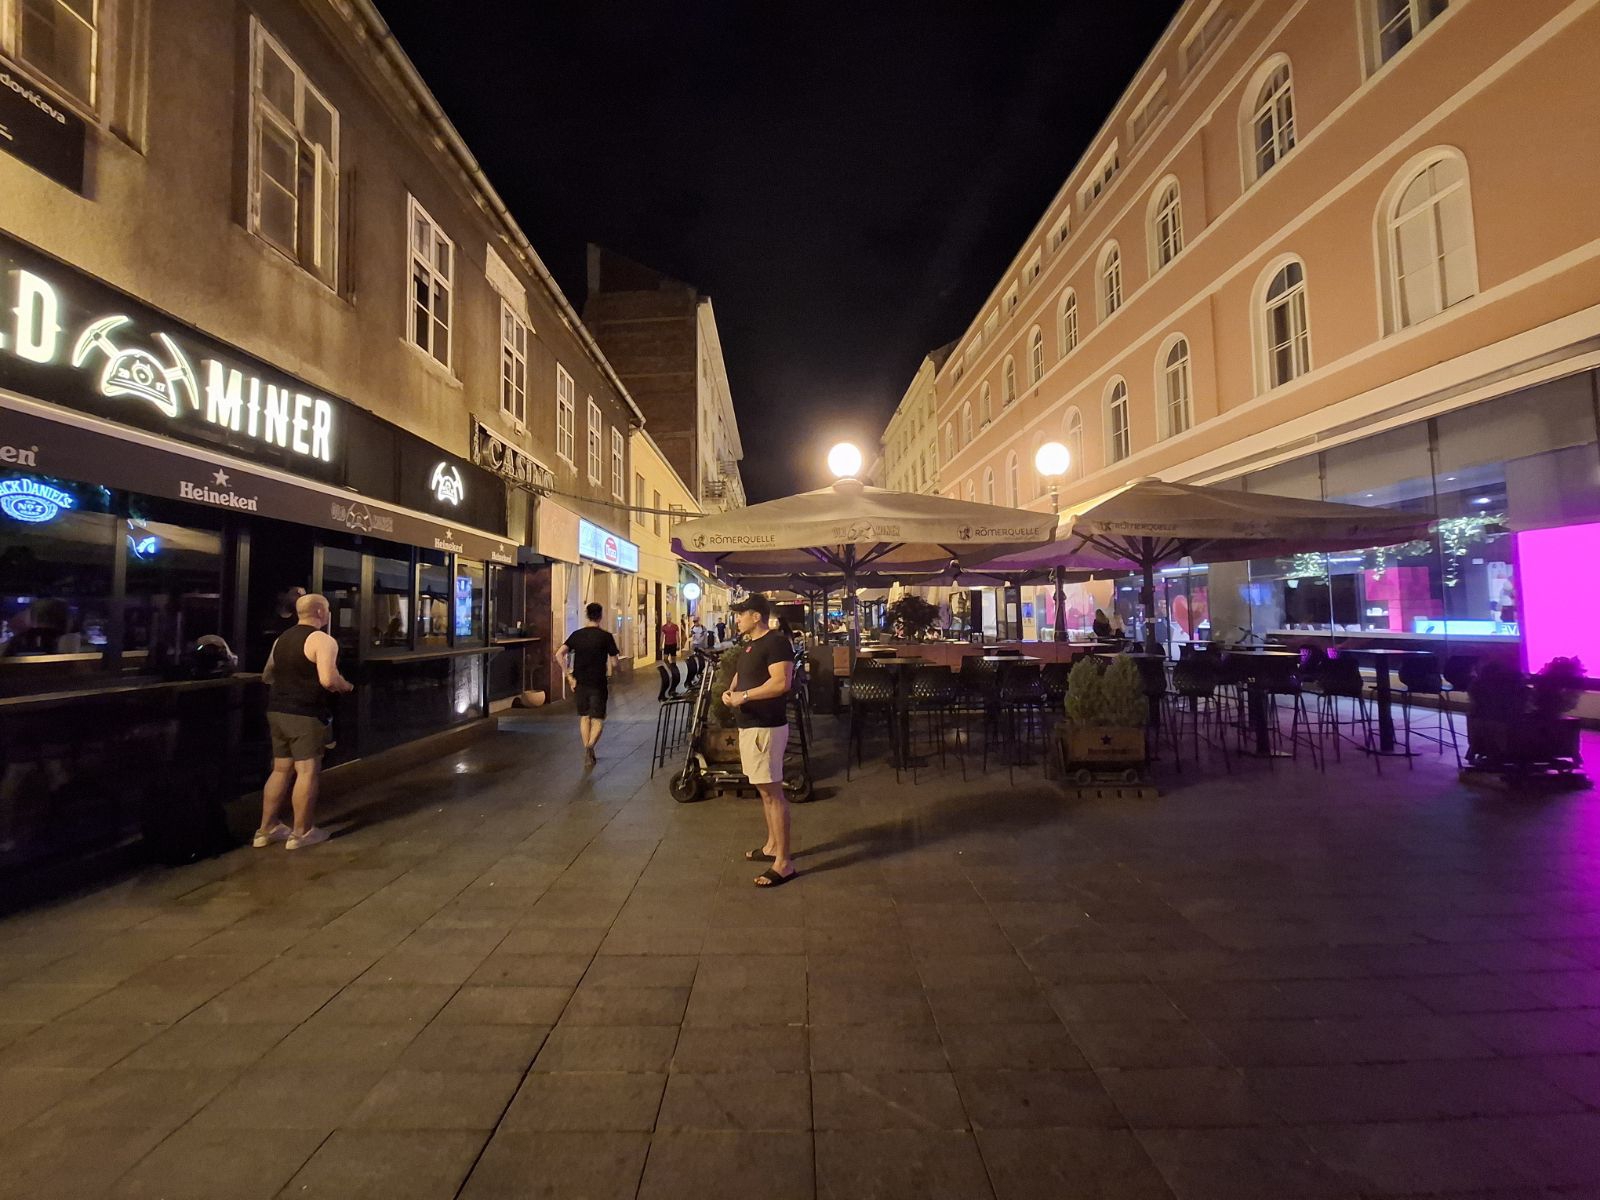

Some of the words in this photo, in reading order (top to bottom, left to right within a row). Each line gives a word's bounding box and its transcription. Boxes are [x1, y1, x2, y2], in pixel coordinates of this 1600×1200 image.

[205, 359, 331, 462] MINER
[487, 436, 554, 494] CASINO
[180, 481, 258, 511] Heineken
